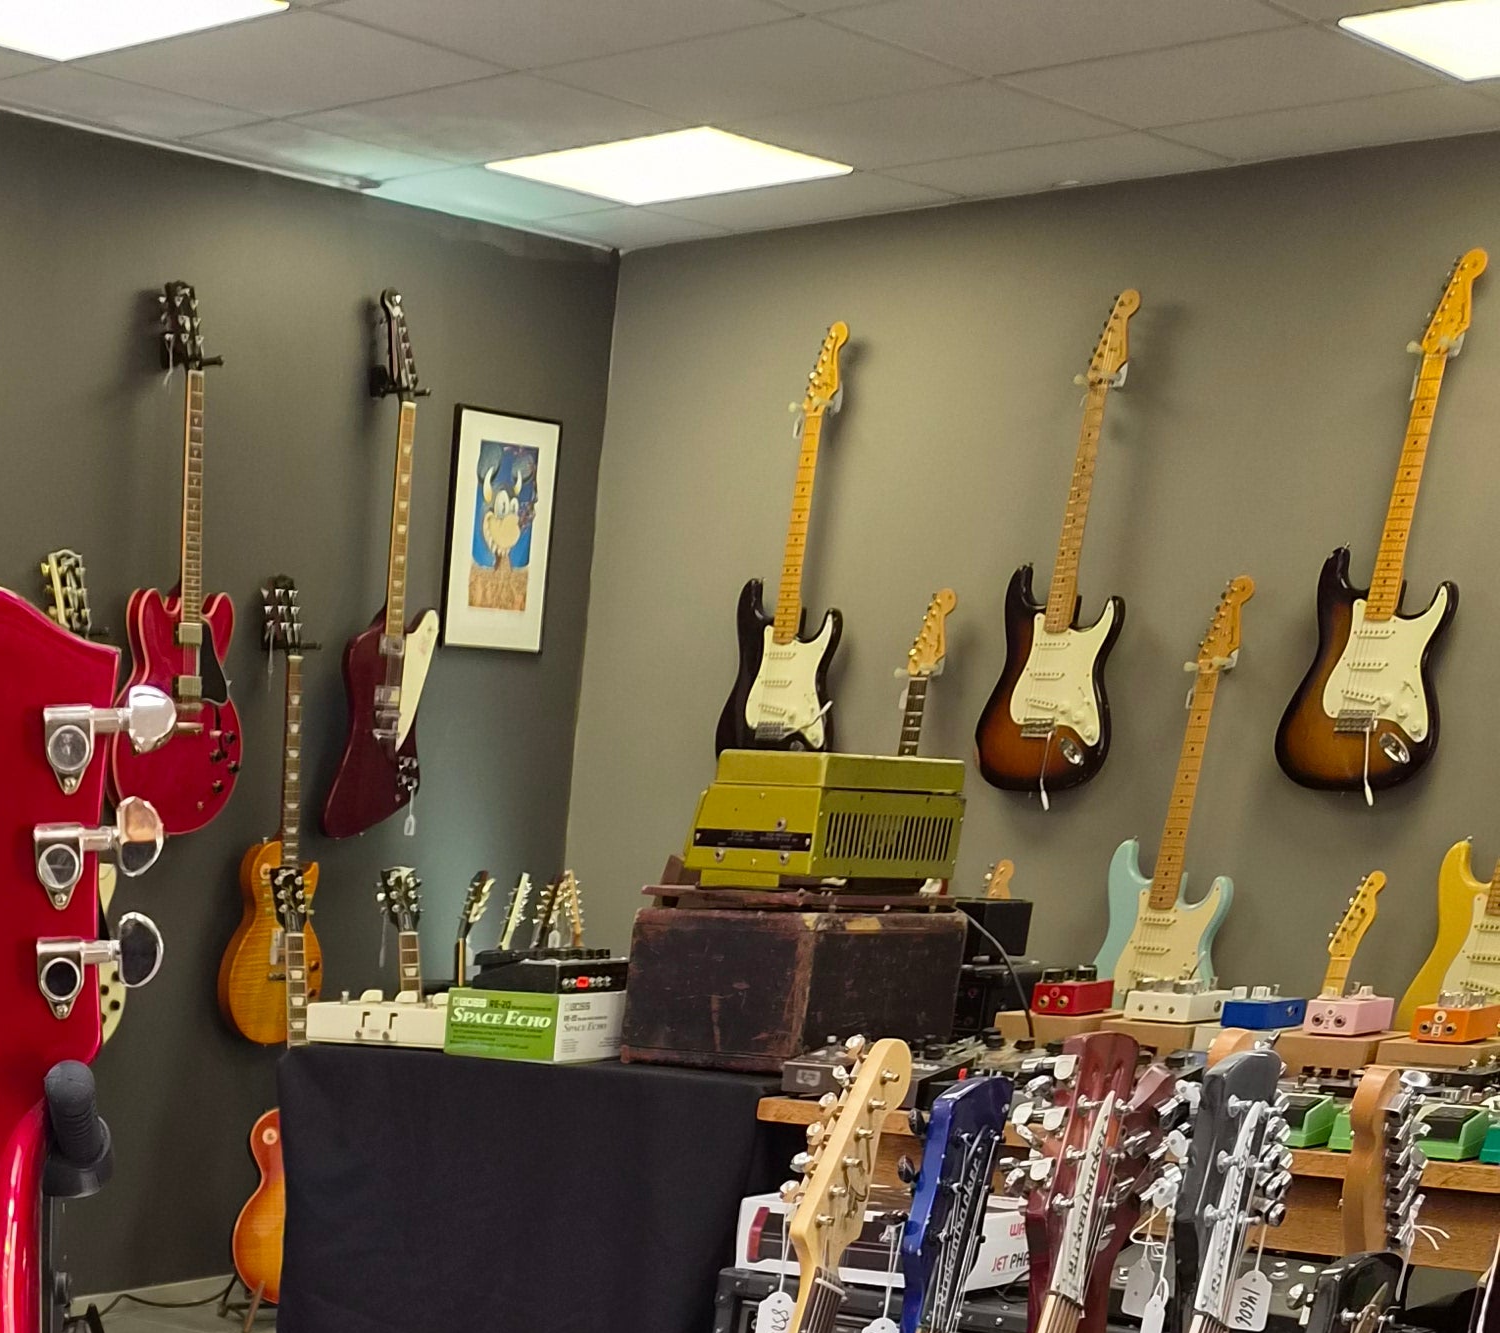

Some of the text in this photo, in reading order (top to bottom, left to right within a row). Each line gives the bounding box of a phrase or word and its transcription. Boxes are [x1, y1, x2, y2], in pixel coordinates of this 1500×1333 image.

[451, 1007, 552, 1028] SPACE ECHO
[991, 1251, 1031, 1273] JET PHA
